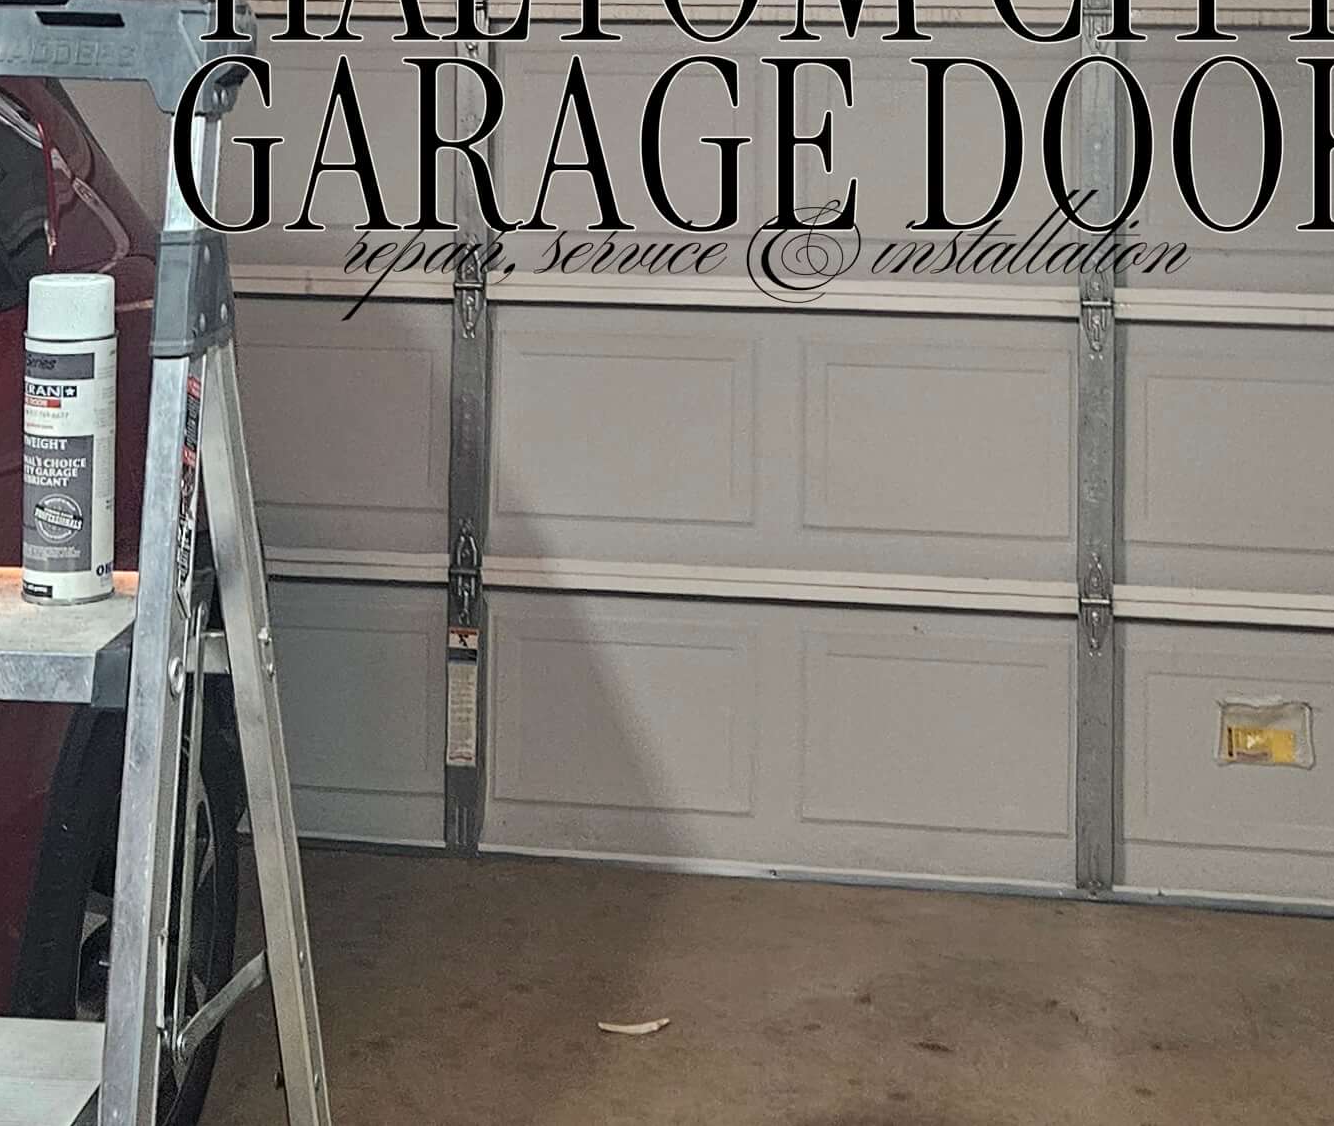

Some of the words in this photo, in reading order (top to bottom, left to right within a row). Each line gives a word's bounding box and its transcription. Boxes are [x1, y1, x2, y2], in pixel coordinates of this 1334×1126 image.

[25, 382, 62, 398] RAN
[43, 457, 87, 469] CHOICE
[35, 466, 79, 478] GARAGE
